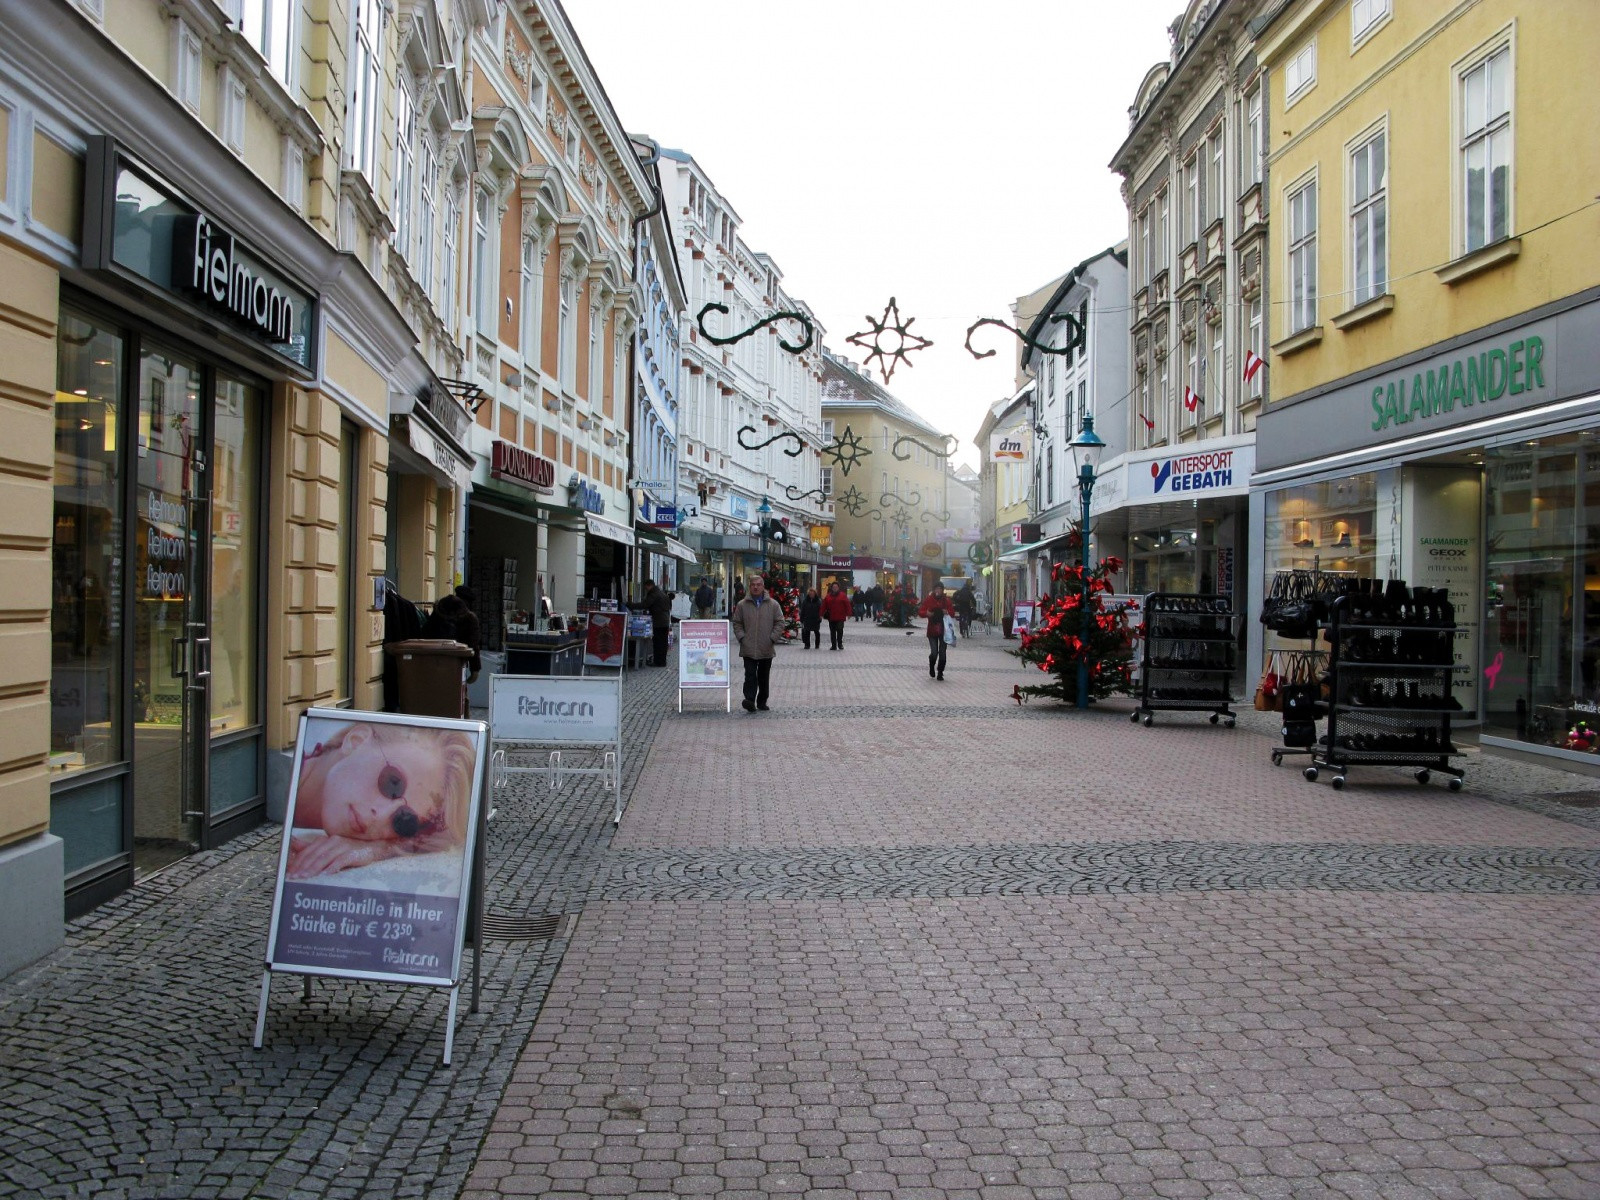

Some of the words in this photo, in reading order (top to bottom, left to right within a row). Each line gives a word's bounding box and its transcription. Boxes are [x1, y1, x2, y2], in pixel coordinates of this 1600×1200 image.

[193, 214, 293, 345] fielmann
[1371, 335, 1545, 431] SALAMANDER
[1000, 438, 1021, 451] dm
[501, 444, 555, 488] DONAULAND
[1172, 451, 1233, 475] INTERSPORT
[1172, 469, 1232, 491] GEBATH
[1420, 537, 1469, 546] SALAMANDER
[1429, 548, 1466, 557] GEOX
[518, 695, 594, 717] fielmann
[294, 892, 385, 916] Sonnenbrille
[389, 902, 403, 918] in
[408, 902, 443, 922] Ihrer
[291, 913, 336, 934] Stärke
[341, 918, 361, 937] für
[383, 947, 439, 967] fielmann
